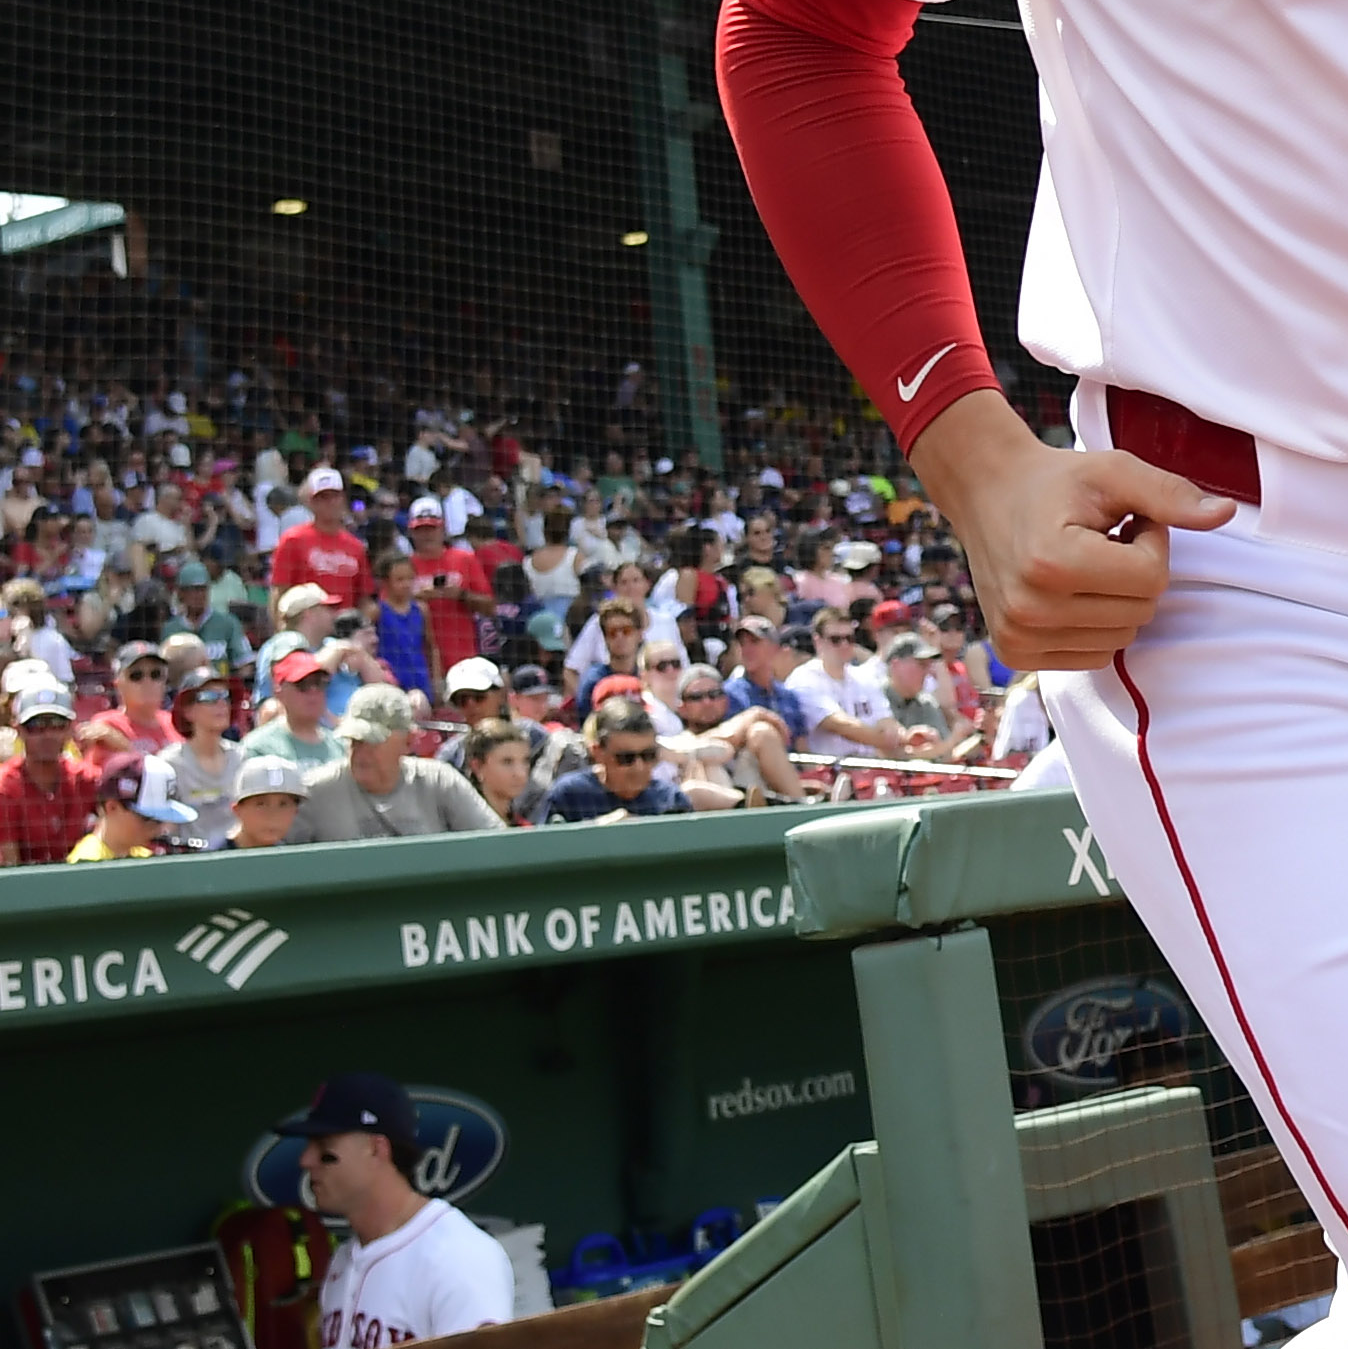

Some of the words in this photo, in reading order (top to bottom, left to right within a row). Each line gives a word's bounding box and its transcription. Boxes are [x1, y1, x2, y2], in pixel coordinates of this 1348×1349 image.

[402, 909, 534, 969] BANK
[544, 901, 601, 954] OF
[612, 883, 797, 946] AMERICA
[0, 948, 169, 1011] ERICA
[1058, 995, 1161, 1071] For
[709, 1069, 856, 1121] redsox.com
